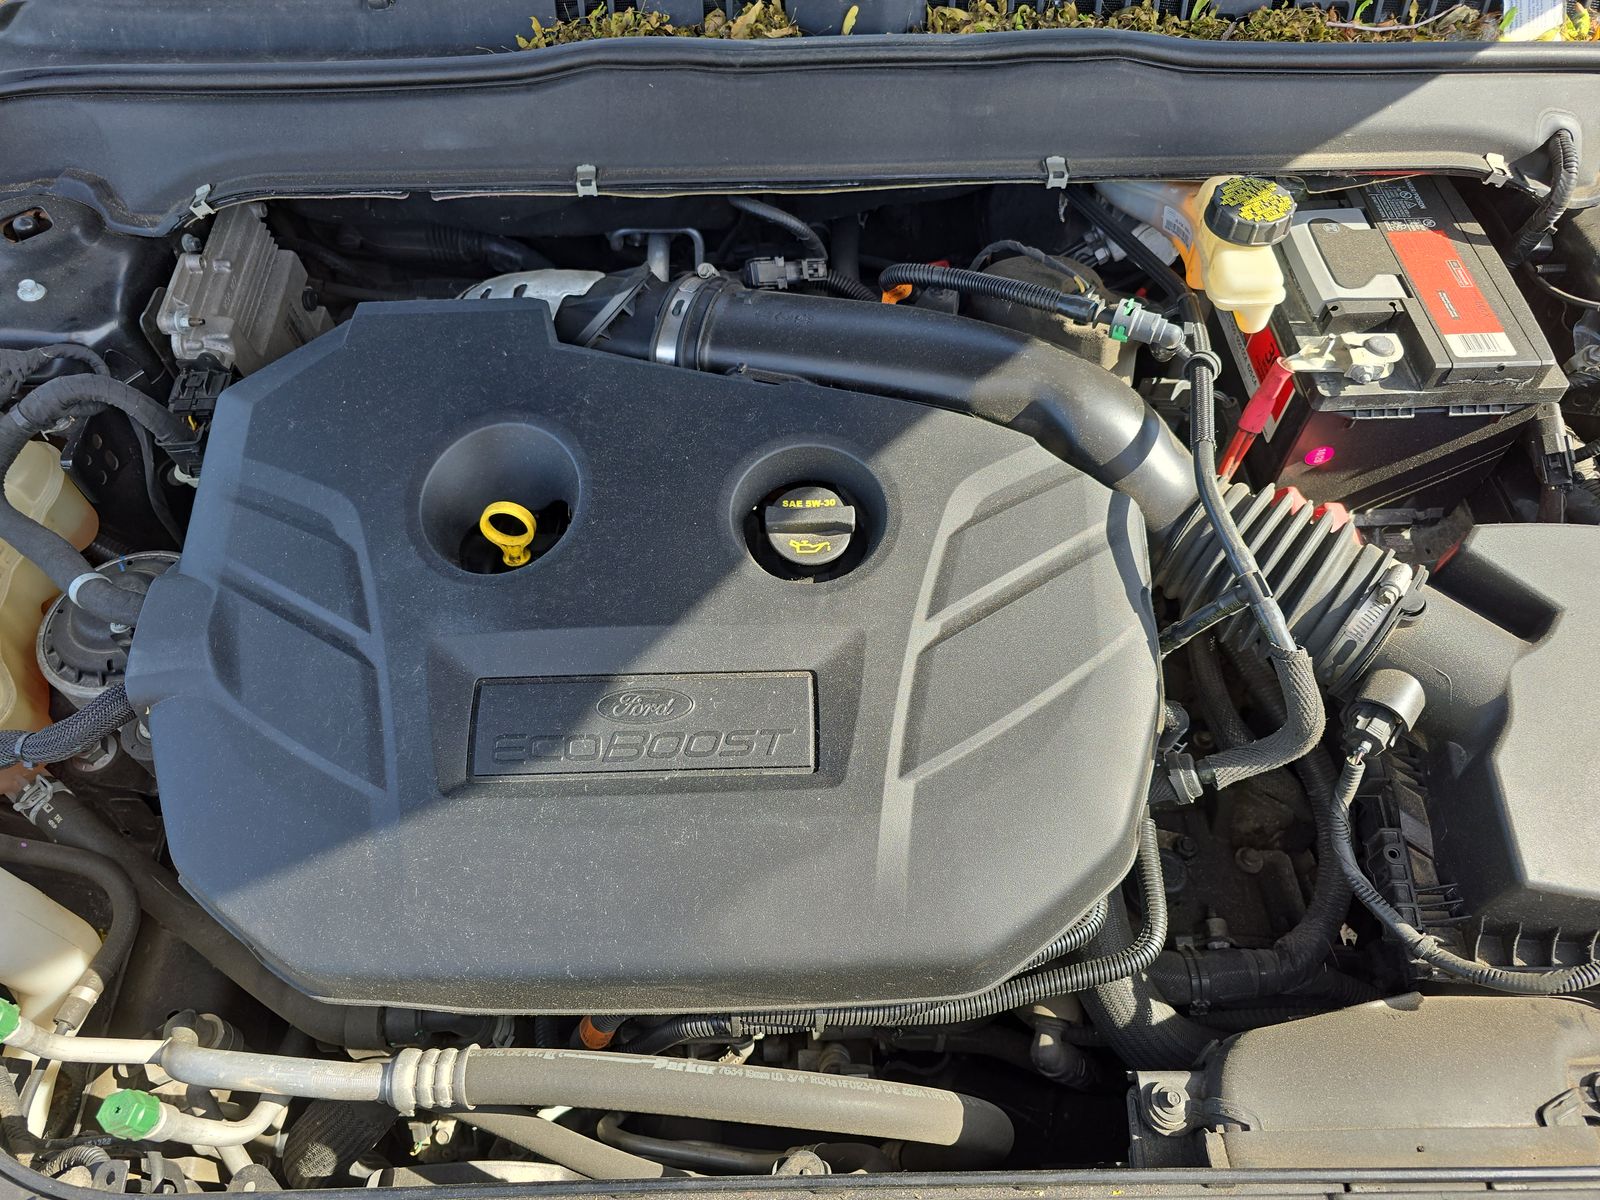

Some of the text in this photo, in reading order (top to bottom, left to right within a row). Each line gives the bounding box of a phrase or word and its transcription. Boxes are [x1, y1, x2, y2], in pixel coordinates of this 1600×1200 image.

[782, 498, 836, 508] SAE 5W-30
[612, 693, 675, 718] Ford
[652, 1058, 717, 1076] Parker
